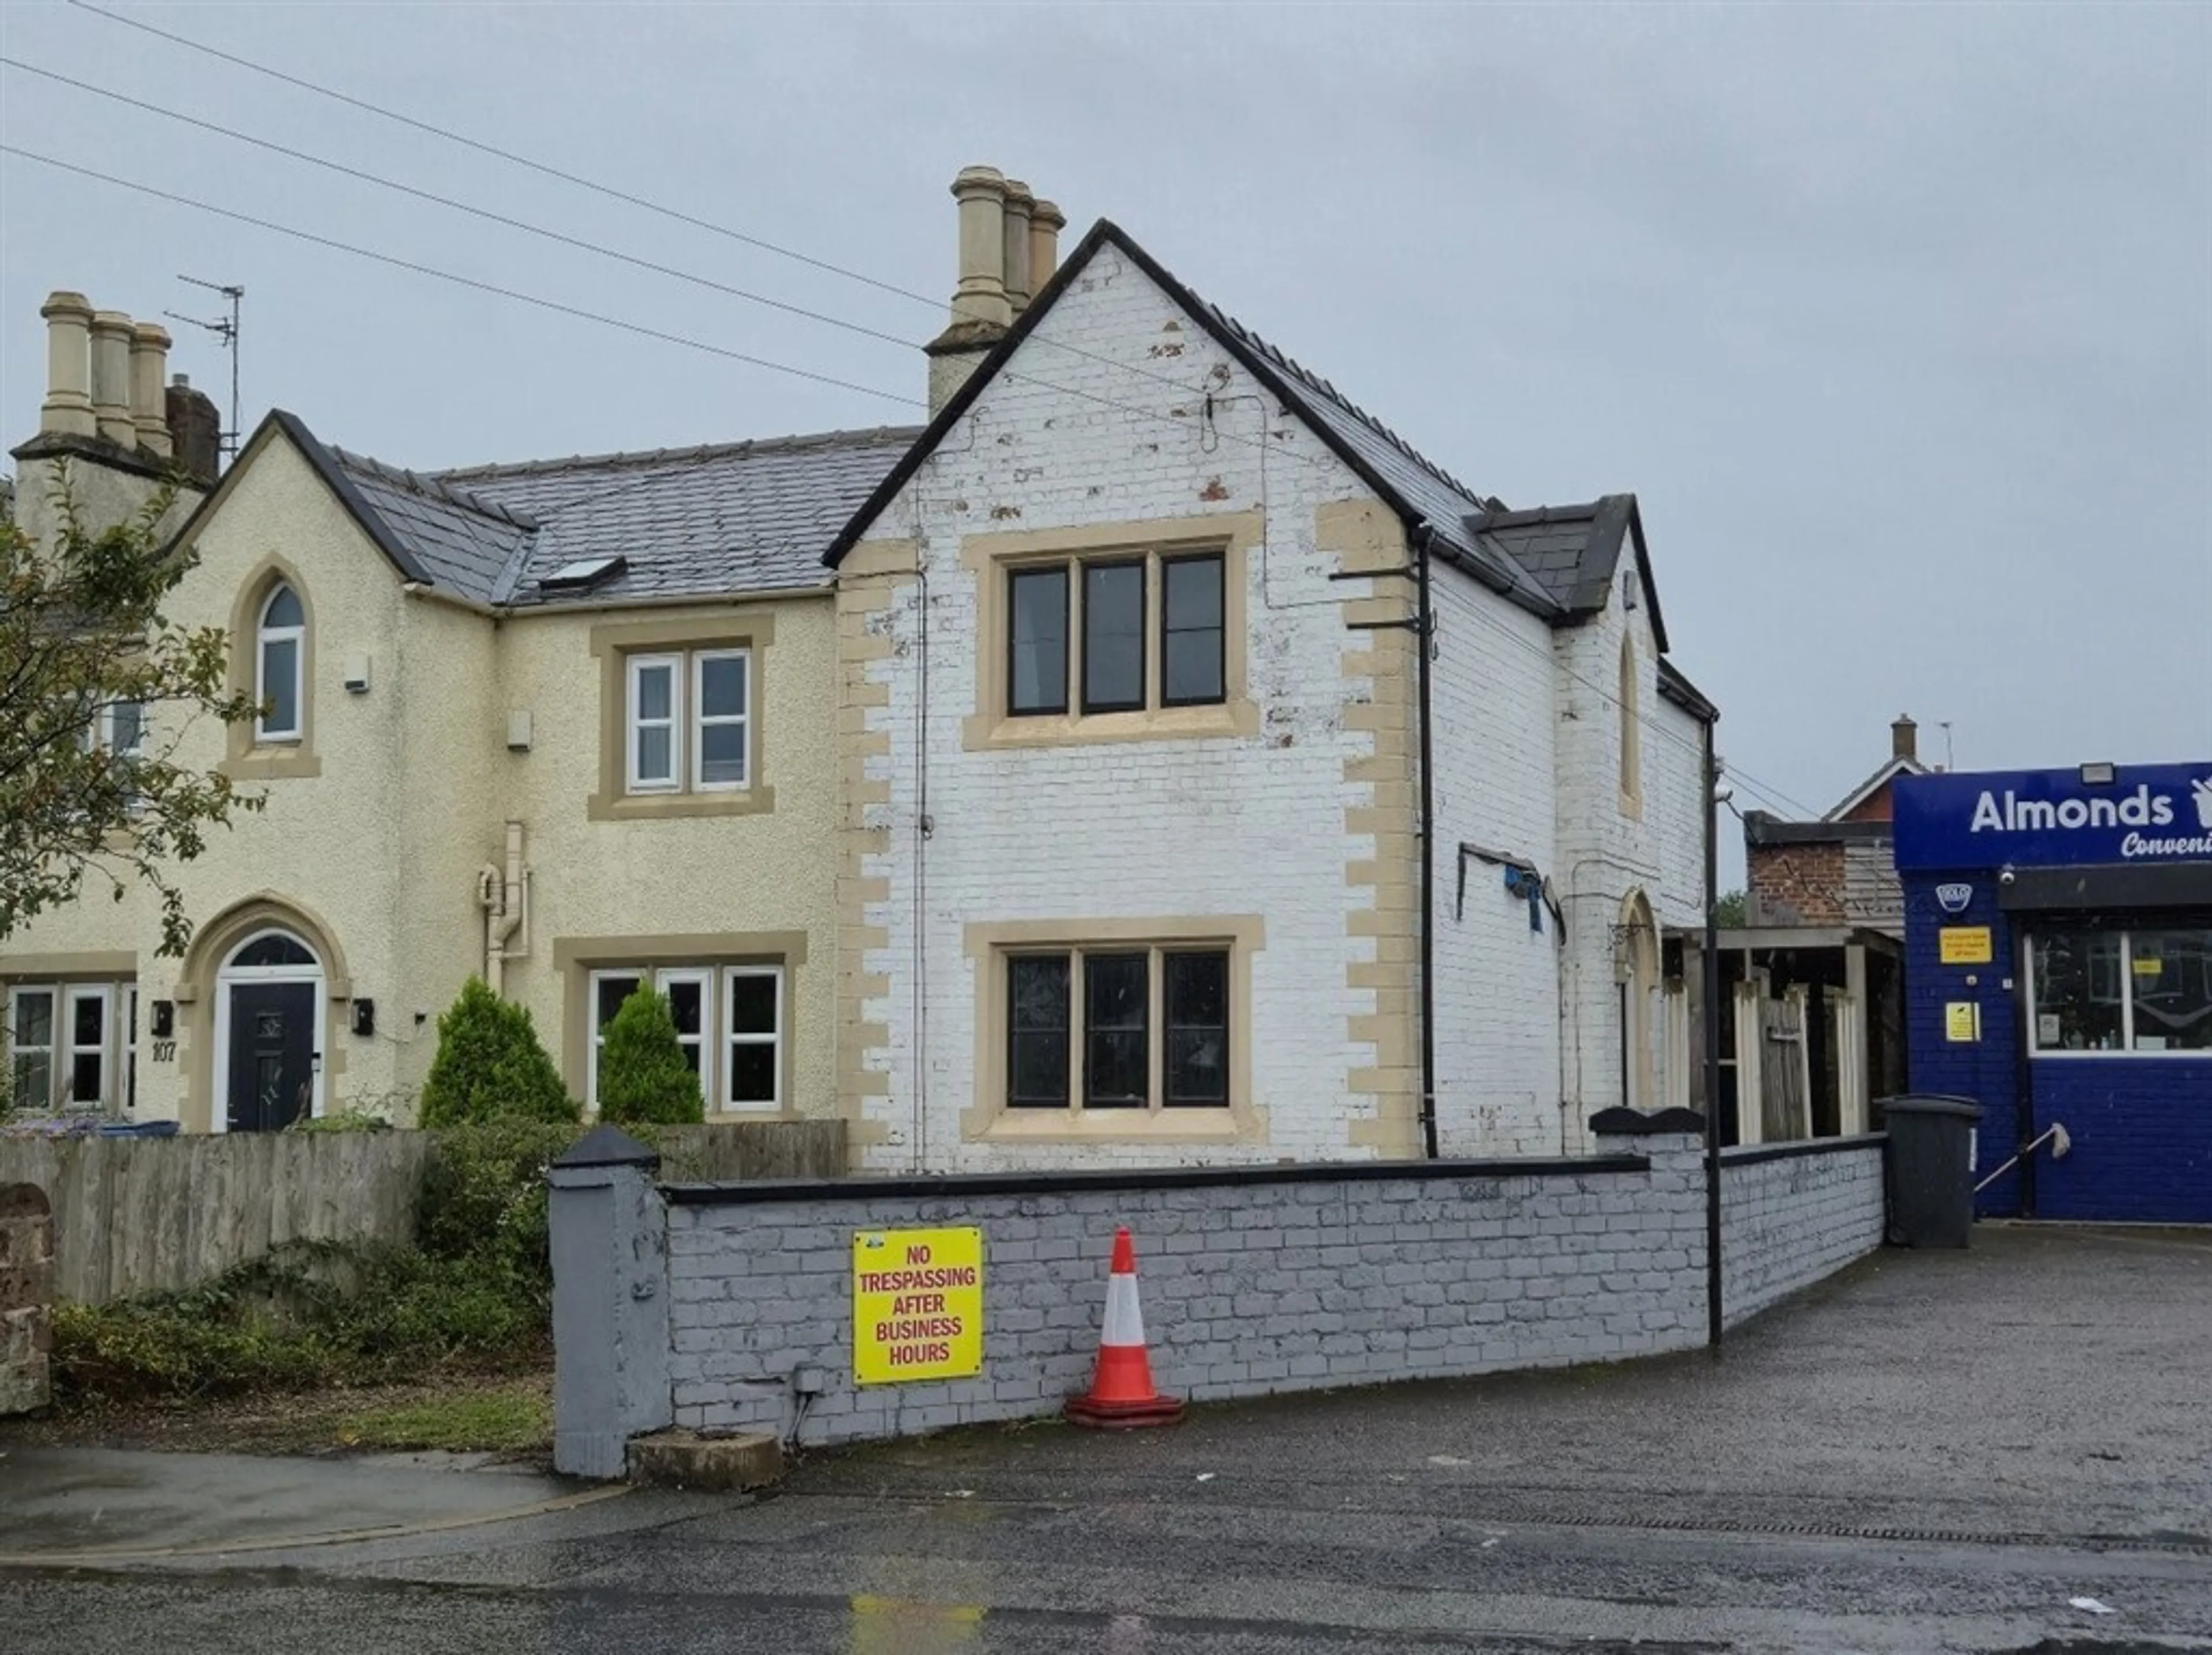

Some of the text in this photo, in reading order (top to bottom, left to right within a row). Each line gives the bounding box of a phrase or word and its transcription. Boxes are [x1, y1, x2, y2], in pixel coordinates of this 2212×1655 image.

[1970, 785, 2174, 832] Almonds
[153, 1041, 177, 1062] 107
[907, 1245, 931, 1265] NO
[859, 1267, 975, 1292] TRESPASSING
[893, 1294, 945, 1315] AFTER
[876, 1316, 963, 1342] BUSINESS
[890, 1342, 950, 1365] HOURS
